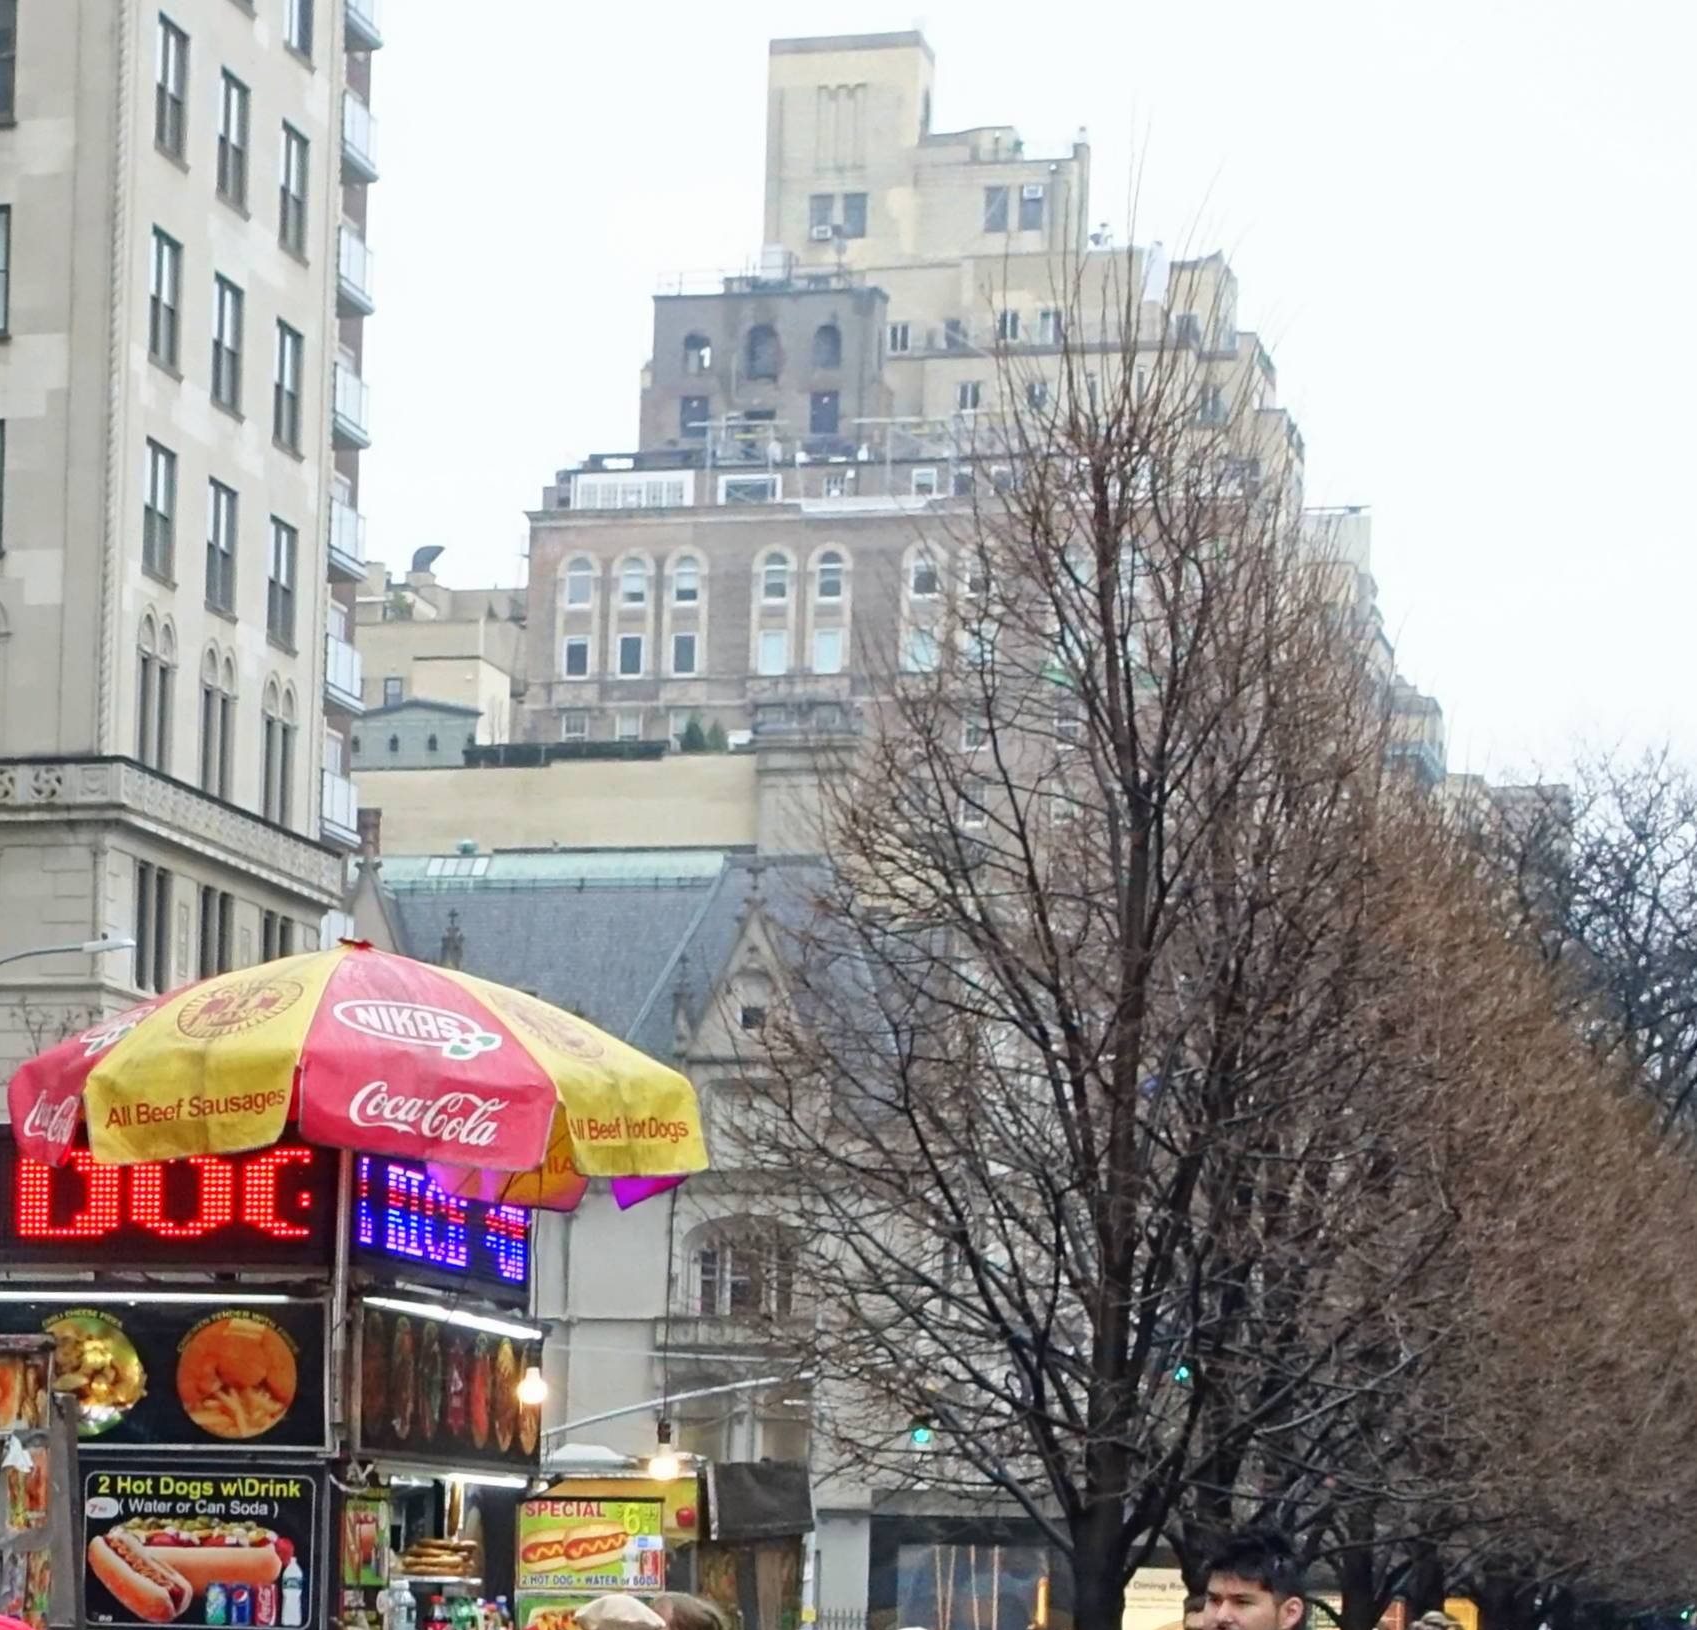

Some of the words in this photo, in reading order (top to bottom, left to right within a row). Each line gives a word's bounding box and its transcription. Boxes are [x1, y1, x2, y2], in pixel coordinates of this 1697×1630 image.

[355, 1004, 461, 1040] NIKAS
[107, 1105, 132, 1129] All
[136, 1100, 183, 1126] Beef
[188, 1088, 286, 1119] Sausages
[349, 1080, 511, 1147] Coca-Cola
[588, 1117, 623, 1140] Beef
[649, 1118, 690, 1145] Dogs
[98, 1476, 110, 1494] 2
[116, 1476, 153, 1494] Hot
[160, 1477, 214, 1499] Dogs
[221, 1478, 302, 1498] w\Drink
[129, 1499, 173, 1514] Water
[176, 1503, 191, 1515] or
[195, 1500, 226, 1515] Can
[230, 1500, 269, 1516] Soda
[525, 1501, 607, 1518] SPECIAL
[530, 1575, 549, 1585] HOT
[553, 1575, 574, 1585] DOG
[585, 1575, 618, 1586] WATER
[633, 1575, 659, 1586] SODA
